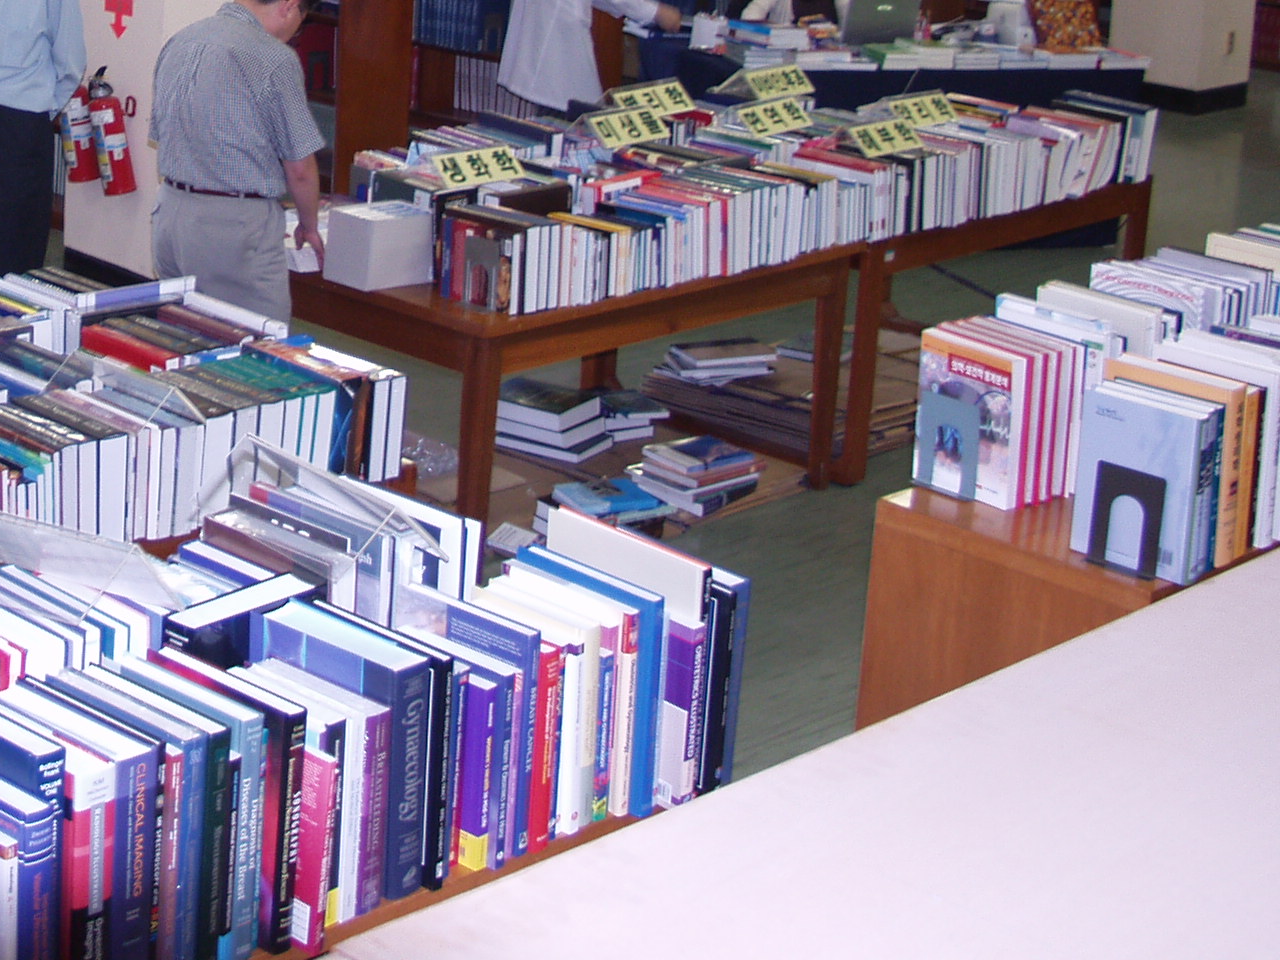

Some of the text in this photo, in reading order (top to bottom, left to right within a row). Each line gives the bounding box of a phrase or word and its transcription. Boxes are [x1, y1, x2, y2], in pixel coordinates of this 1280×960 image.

[596, 111, 662, 141] 미생물
[441, 149, 518, 183] 생화학
[691, 645, 703, 700] OBSTETRICS
[398, 697, 424, 821] Gynaecology
[524, 686, 536, 772] BREAST CANCER
[686, 699, 698, 758] ILLUSTRATED
[91, 807, 101, 909] RADIOLOGY ILLUSTRATED
[133, 762, 146, 897] CLINICAL IMAGING
[236, 776, 251, 900] Diseases of the Breast
[248, 798, 258, 868] Diagnosis of
[288, 790, 302, 863] SONOGRAPHY
